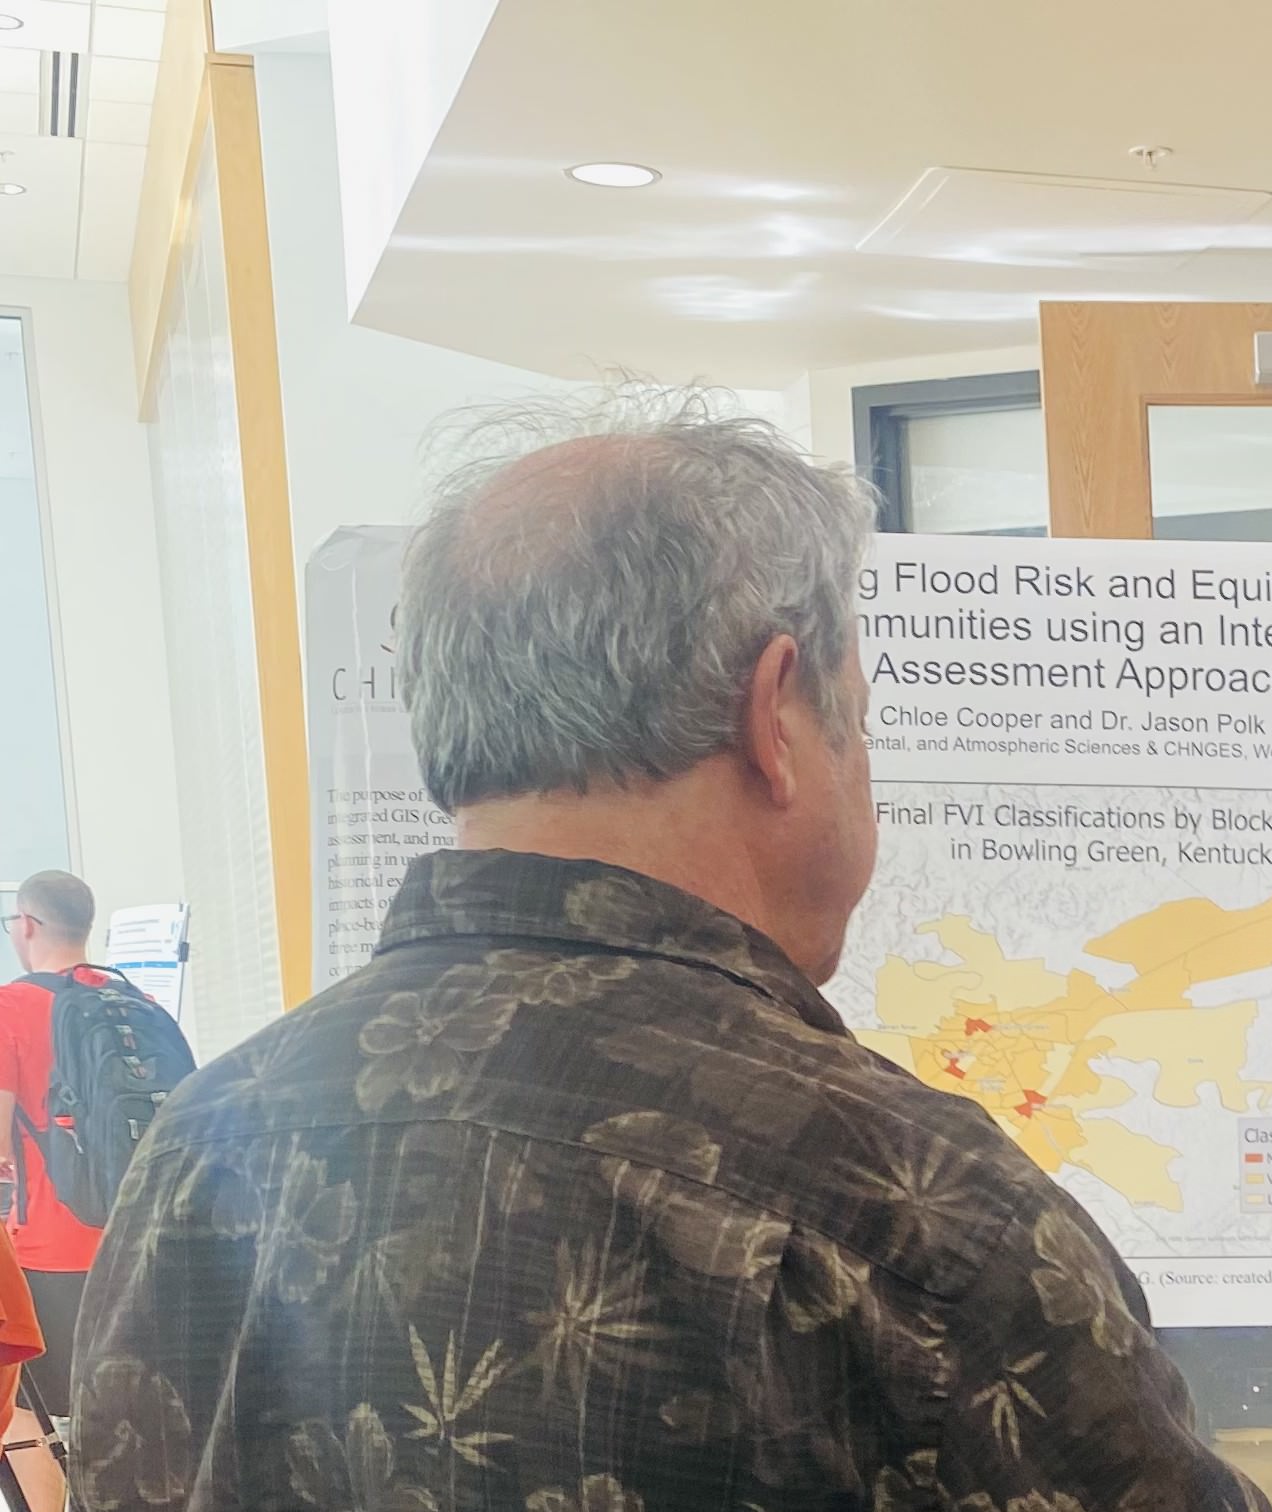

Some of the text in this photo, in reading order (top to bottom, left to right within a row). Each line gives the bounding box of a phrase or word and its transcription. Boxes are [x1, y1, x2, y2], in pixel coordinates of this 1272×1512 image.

[896, 562, 998, 594] Flood
[1015, 565, 1095, 597] Risk
[1108, 569, 1175, 600] and
[1046, 612, 1145, 651] using
[1158, 620, 1204, 646] an
[871, 651, 1106, 689] Assessment
[880, 705, 1266, 735] Chloe Cooper and Dr. Jason Polk
[916, 737, 948, 752] and
[953, 738, 1060, 755] Atmospheric
[1064, 738, 1141, 755] Sciences
[1146, 741, 1159, 755] &
[1164, 741, 1248, 761] CHNGES,
[391, 809, 420, 823] GIS
[875, 802, 932, 825] Final
[944, 804, 985, 826] FVI
[994, 805, 1165, 829] Classifications
[1175, 807, 1202, 830] by
[403, 832, 428, 846] and
[950, 838, 971, 860] in
[982, 838, 1078, 867] Bowling
[1087, 840, 1167, 867] Green,
[1159, 1271, 1218, 1288] (Source:
[1222, 1270, 1272, 1284] created
